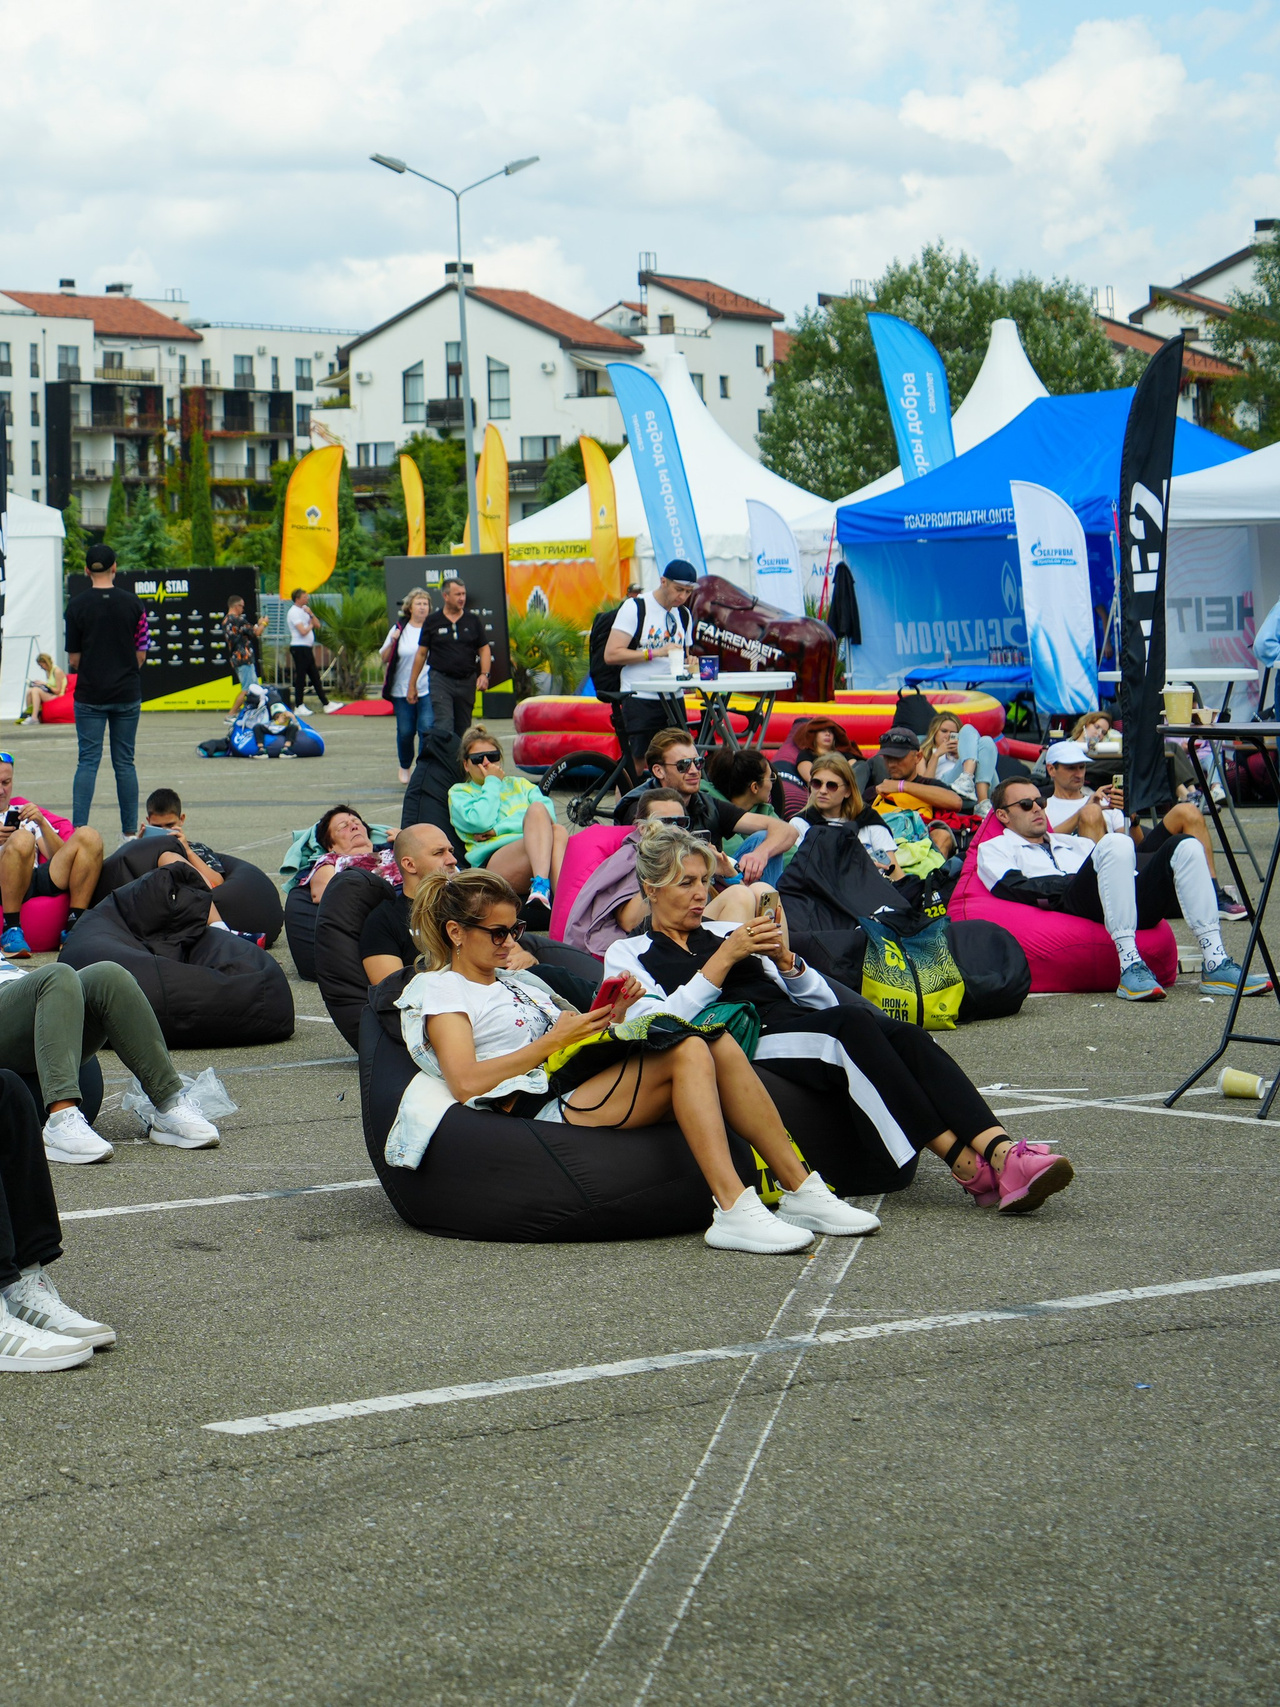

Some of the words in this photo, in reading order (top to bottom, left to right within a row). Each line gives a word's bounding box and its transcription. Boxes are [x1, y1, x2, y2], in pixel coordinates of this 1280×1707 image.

[901, 372, 924, 435] добра
[911, 438, 930, 478] оры
[543, 544, 587, 555] ТРИАТЛОН
[134, 581, 157, 594] IRON
[165, 579, 189, 593] STAR
[696, 620, 783, 661] FAHRENHEIT
[542, 770, 558, 792] SWISS
[924, 904, 947, 918] 226
[882, 998, 901, 1008] IRON
